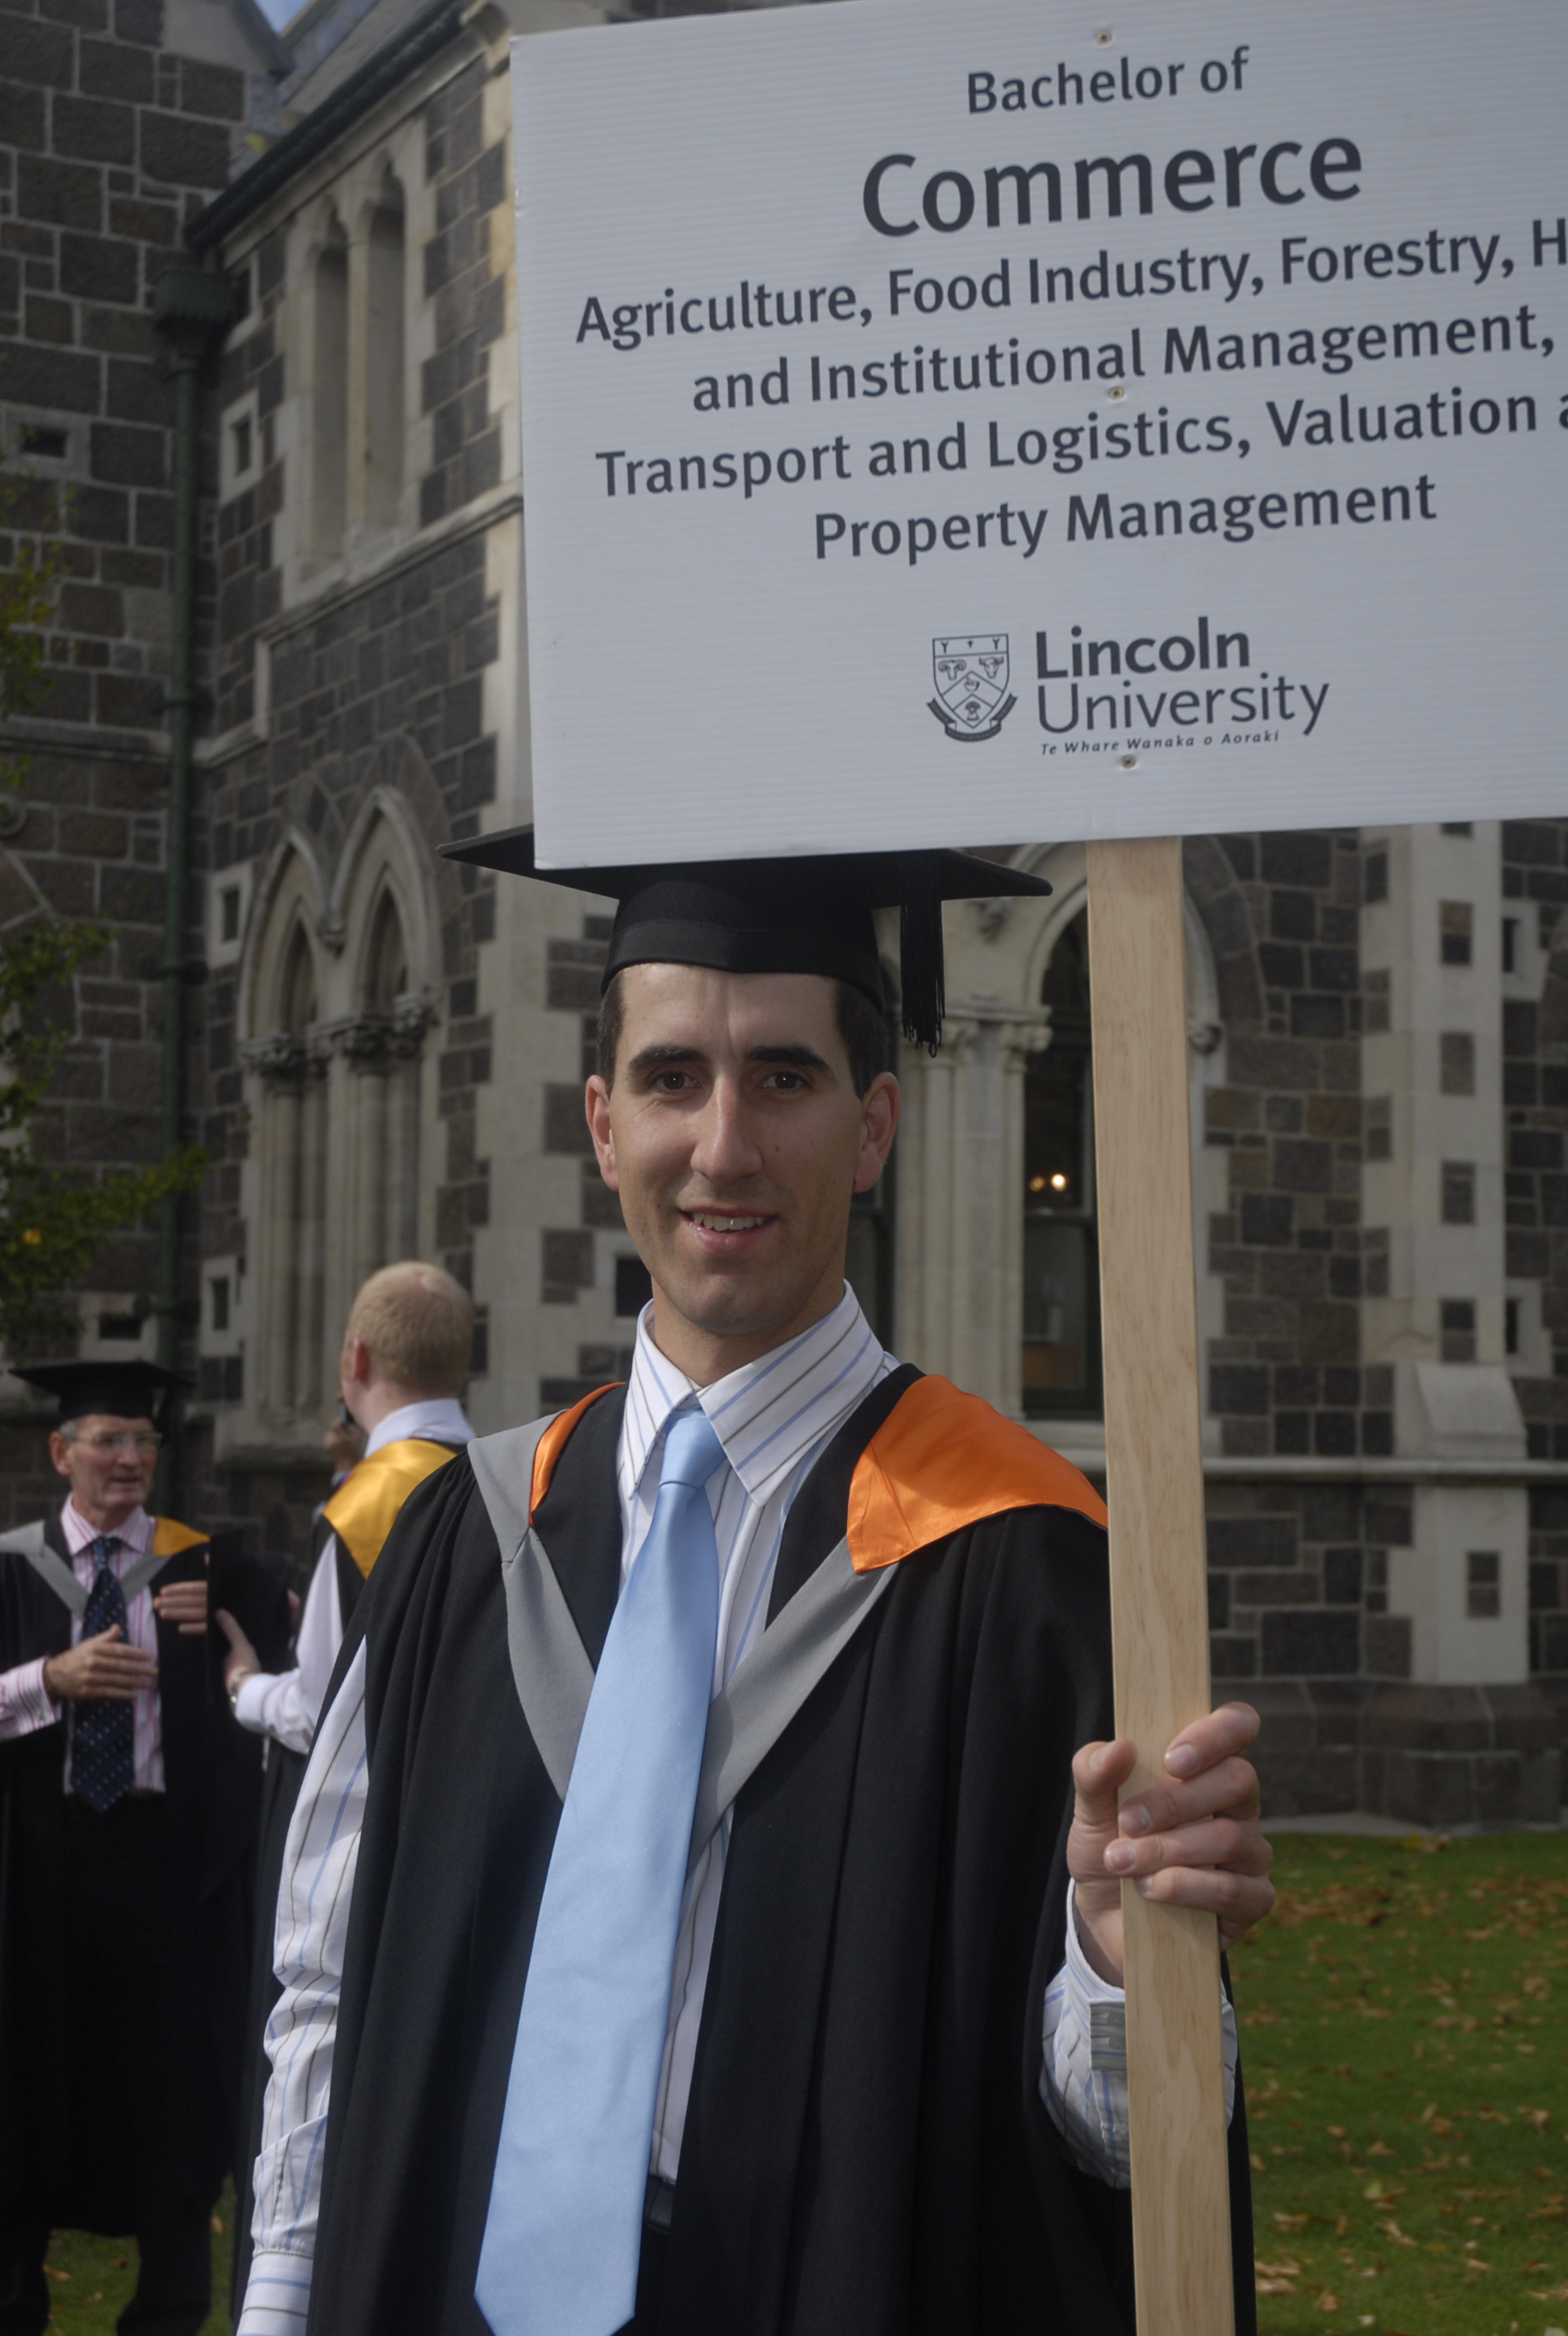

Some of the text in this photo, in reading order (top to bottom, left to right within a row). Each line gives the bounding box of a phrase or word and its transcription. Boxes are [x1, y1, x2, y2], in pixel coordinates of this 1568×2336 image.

[969, 46, 1250, 114] Bachelor of
[863, 138, 1362, 236] Commerce
[577, 281, 871, 350] Agriculture,
[890, 259, 1011, 315] Food
[1030, 248, 1263, 303] Industry,
[1282, 230, 1513, 285] Forestry,
[694, 306, 1553, 411] and Institutional Management,
[596, 436, 851, 498] Transport
[869, 422, 966, 476] and
[989, 407, 1249, 473] Logistics,
[1266, 386, 1536, 446] Valuation
[816, 475, 1437, 565] Property Management
[1036, 616, 1249, 679] Lincoln
[1037, 673, 1329, 736] University
[1041, 730, 1279, 755] Te Whare Wanaka o Aoraki
